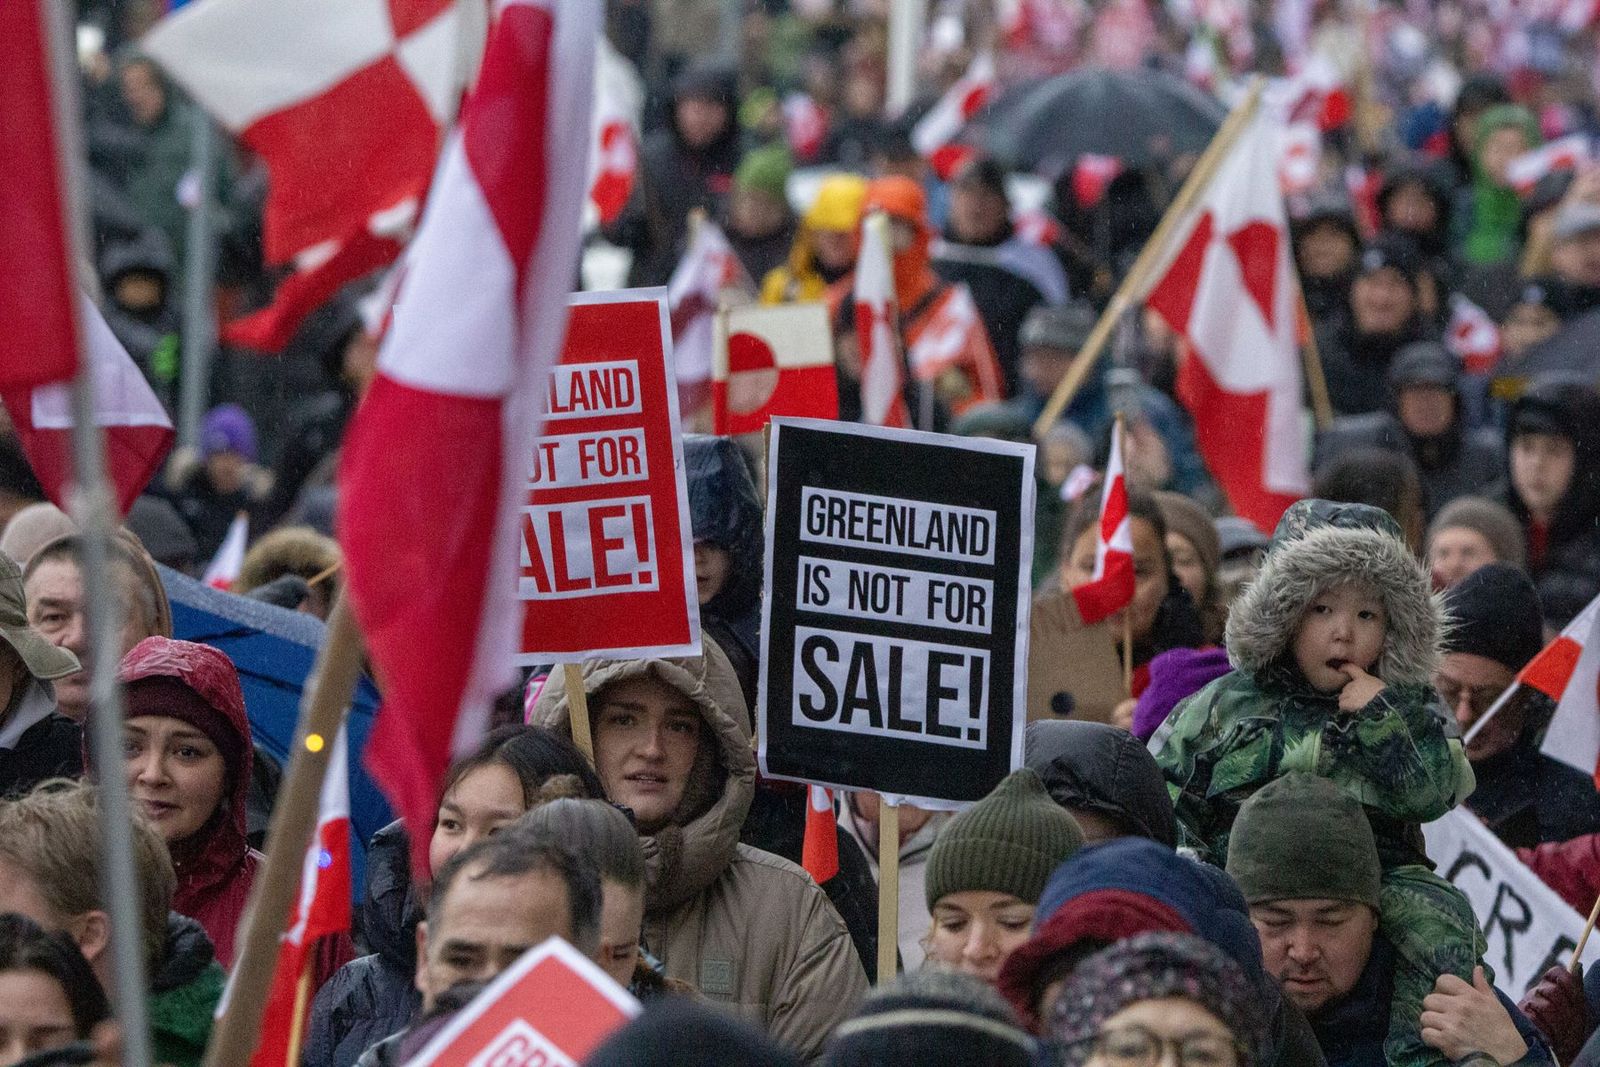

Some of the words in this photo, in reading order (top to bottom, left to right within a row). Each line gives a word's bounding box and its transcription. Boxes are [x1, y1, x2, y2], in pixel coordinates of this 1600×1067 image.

[541, 368, 635, 414] LAND
[578, 435, 642, 480] FOR
[514, 503, 652, 593] ALE!
[806, 493, 990, 557] GREENLAND
[803, 563, 831, 606] IS
[848, 569, 910, 616] NOT
[927, 580, 986, 626] FOR
[799, 635, 984, 741] SALE!
